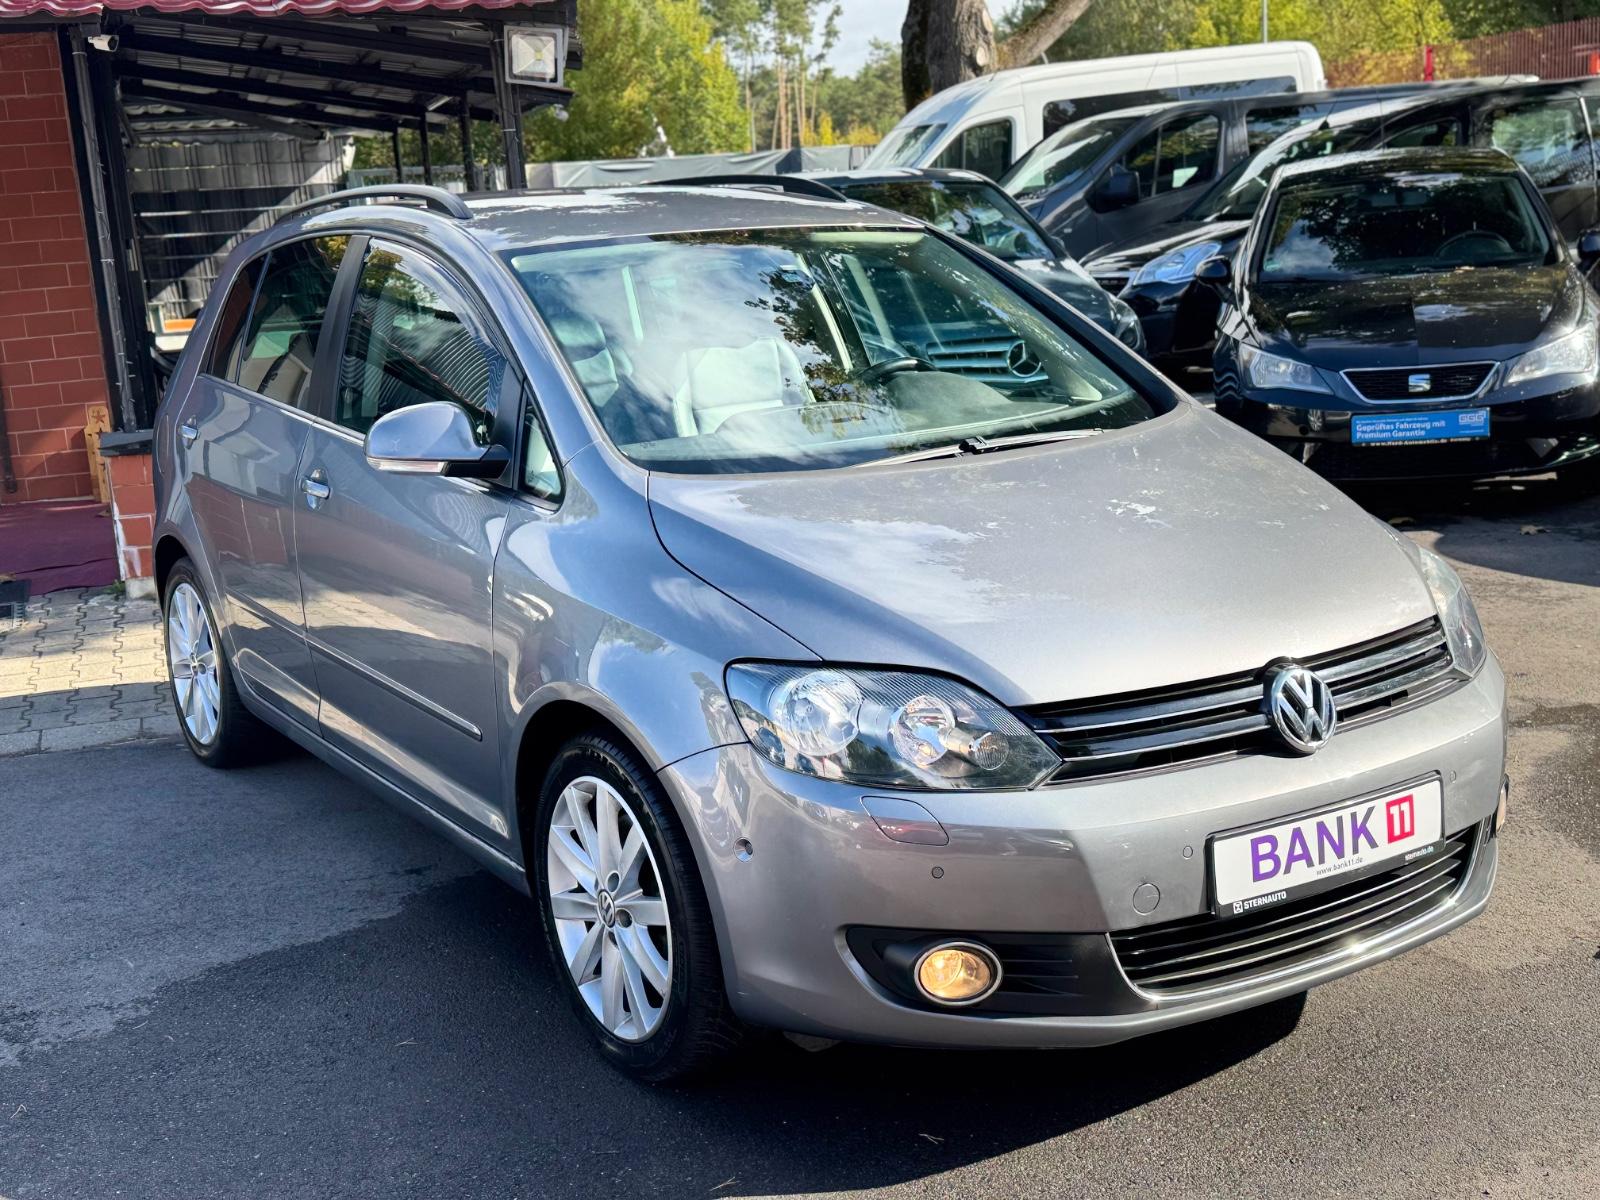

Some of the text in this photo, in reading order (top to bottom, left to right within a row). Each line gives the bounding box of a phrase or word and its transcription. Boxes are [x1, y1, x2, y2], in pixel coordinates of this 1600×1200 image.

[1356, 422, 1394, 433] Geprüftes
[1395, 420, 1431, 430] Fahrzeug
[1432, 420, 1446, 428] mit
[1356, 428, 1426, 440] Premium Garantie
[1250, 799, 1413, 883] BANK 11
[1316, 857, 1364, 875] www.bank11.de
[1243, 890, 1287, 910] STERNAUTO
